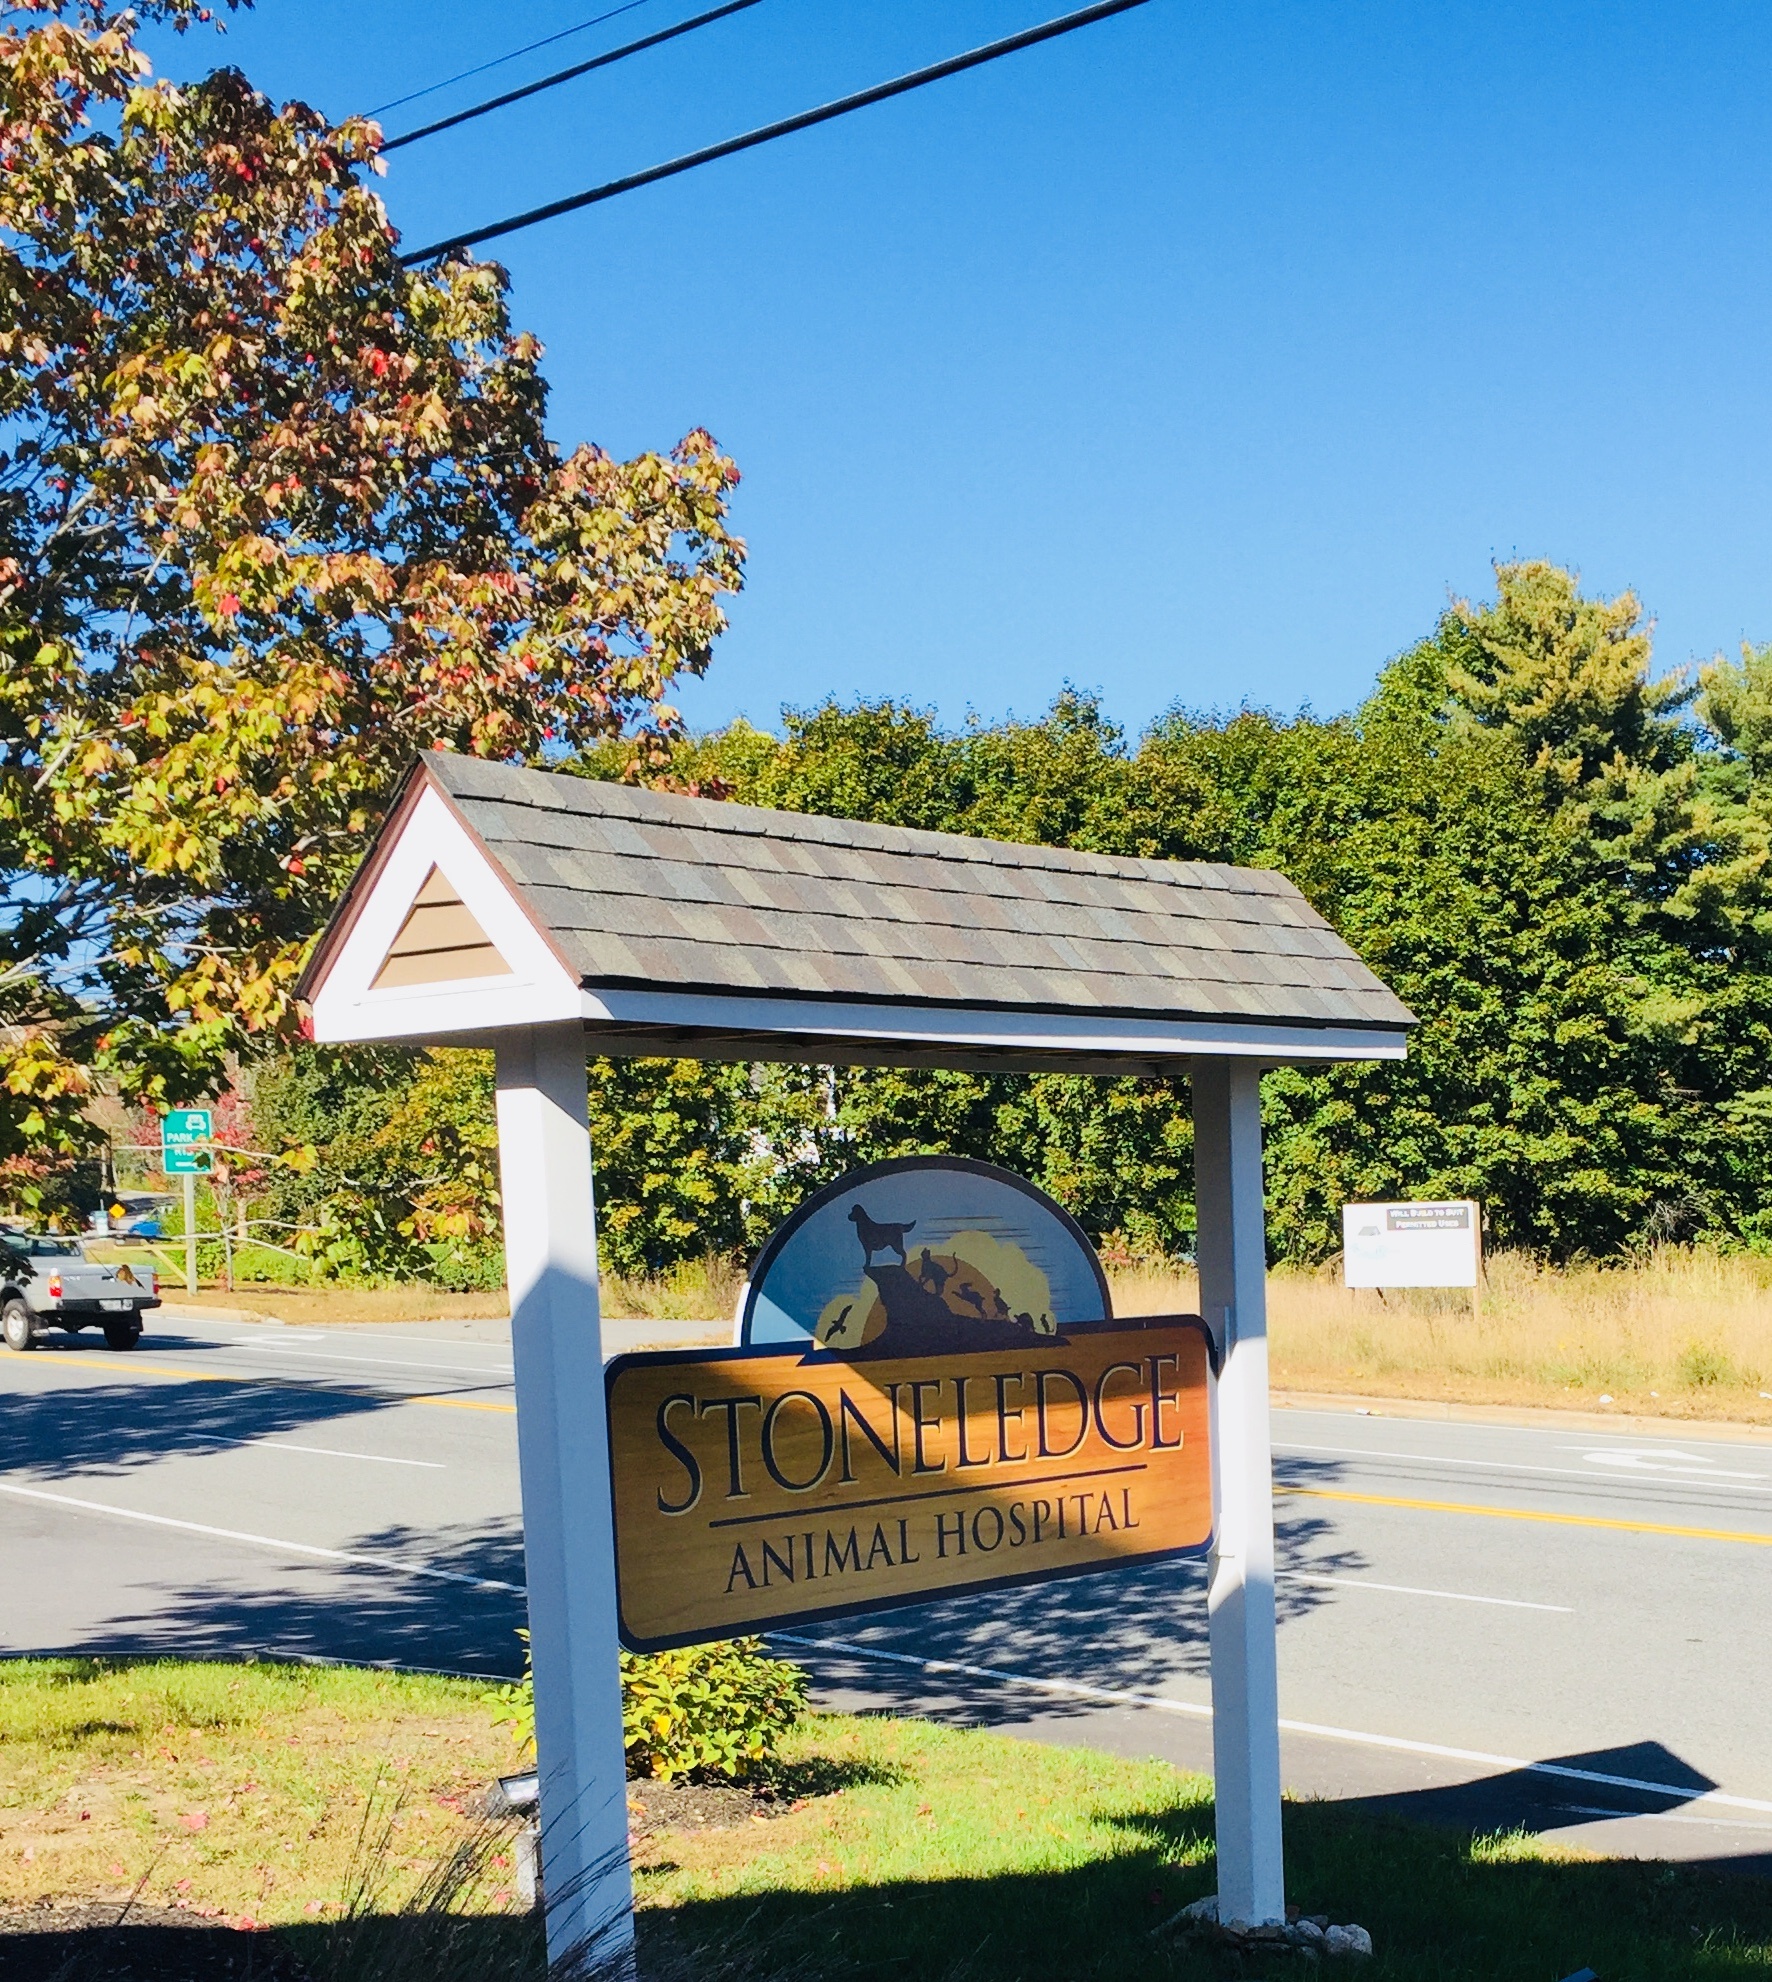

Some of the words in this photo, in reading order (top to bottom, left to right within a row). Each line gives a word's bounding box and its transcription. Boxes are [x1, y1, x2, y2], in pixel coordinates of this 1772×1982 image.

[166, 1132, 194, 1143] PARK
[656, 1353, 1184, 1516] STONELEDGE
[724, 1520, 919, 1593] ANIMAL
[936, 1487, 1140, 1559] HOSPITAL
